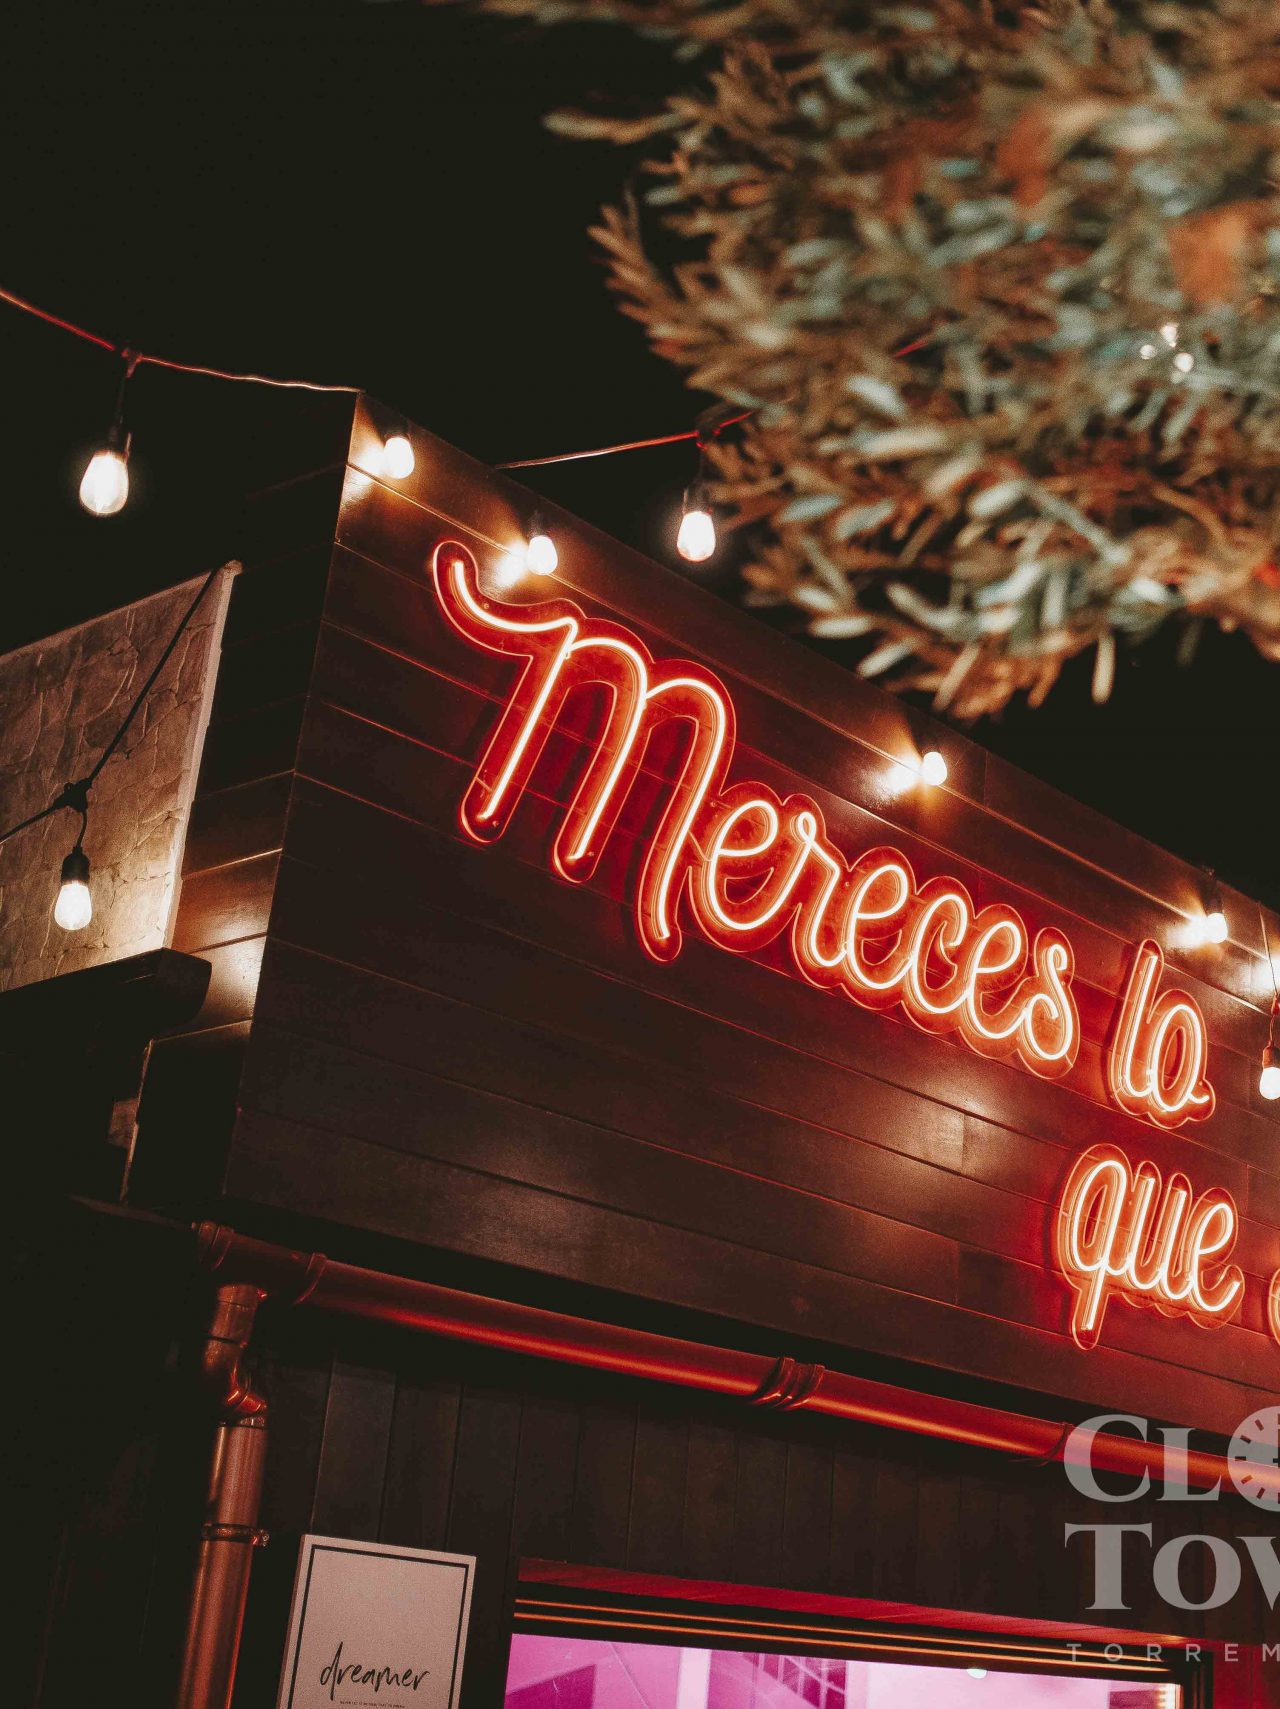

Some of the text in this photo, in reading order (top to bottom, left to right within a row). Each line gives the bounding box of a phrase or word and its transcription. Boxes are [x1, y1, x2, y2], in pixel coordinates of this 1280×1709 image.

[446, 556, 1212, 1116] Mereces lo
[1064, 1156, 1242, 1333] que
[319, 1641, 431, 1701] dreamer
